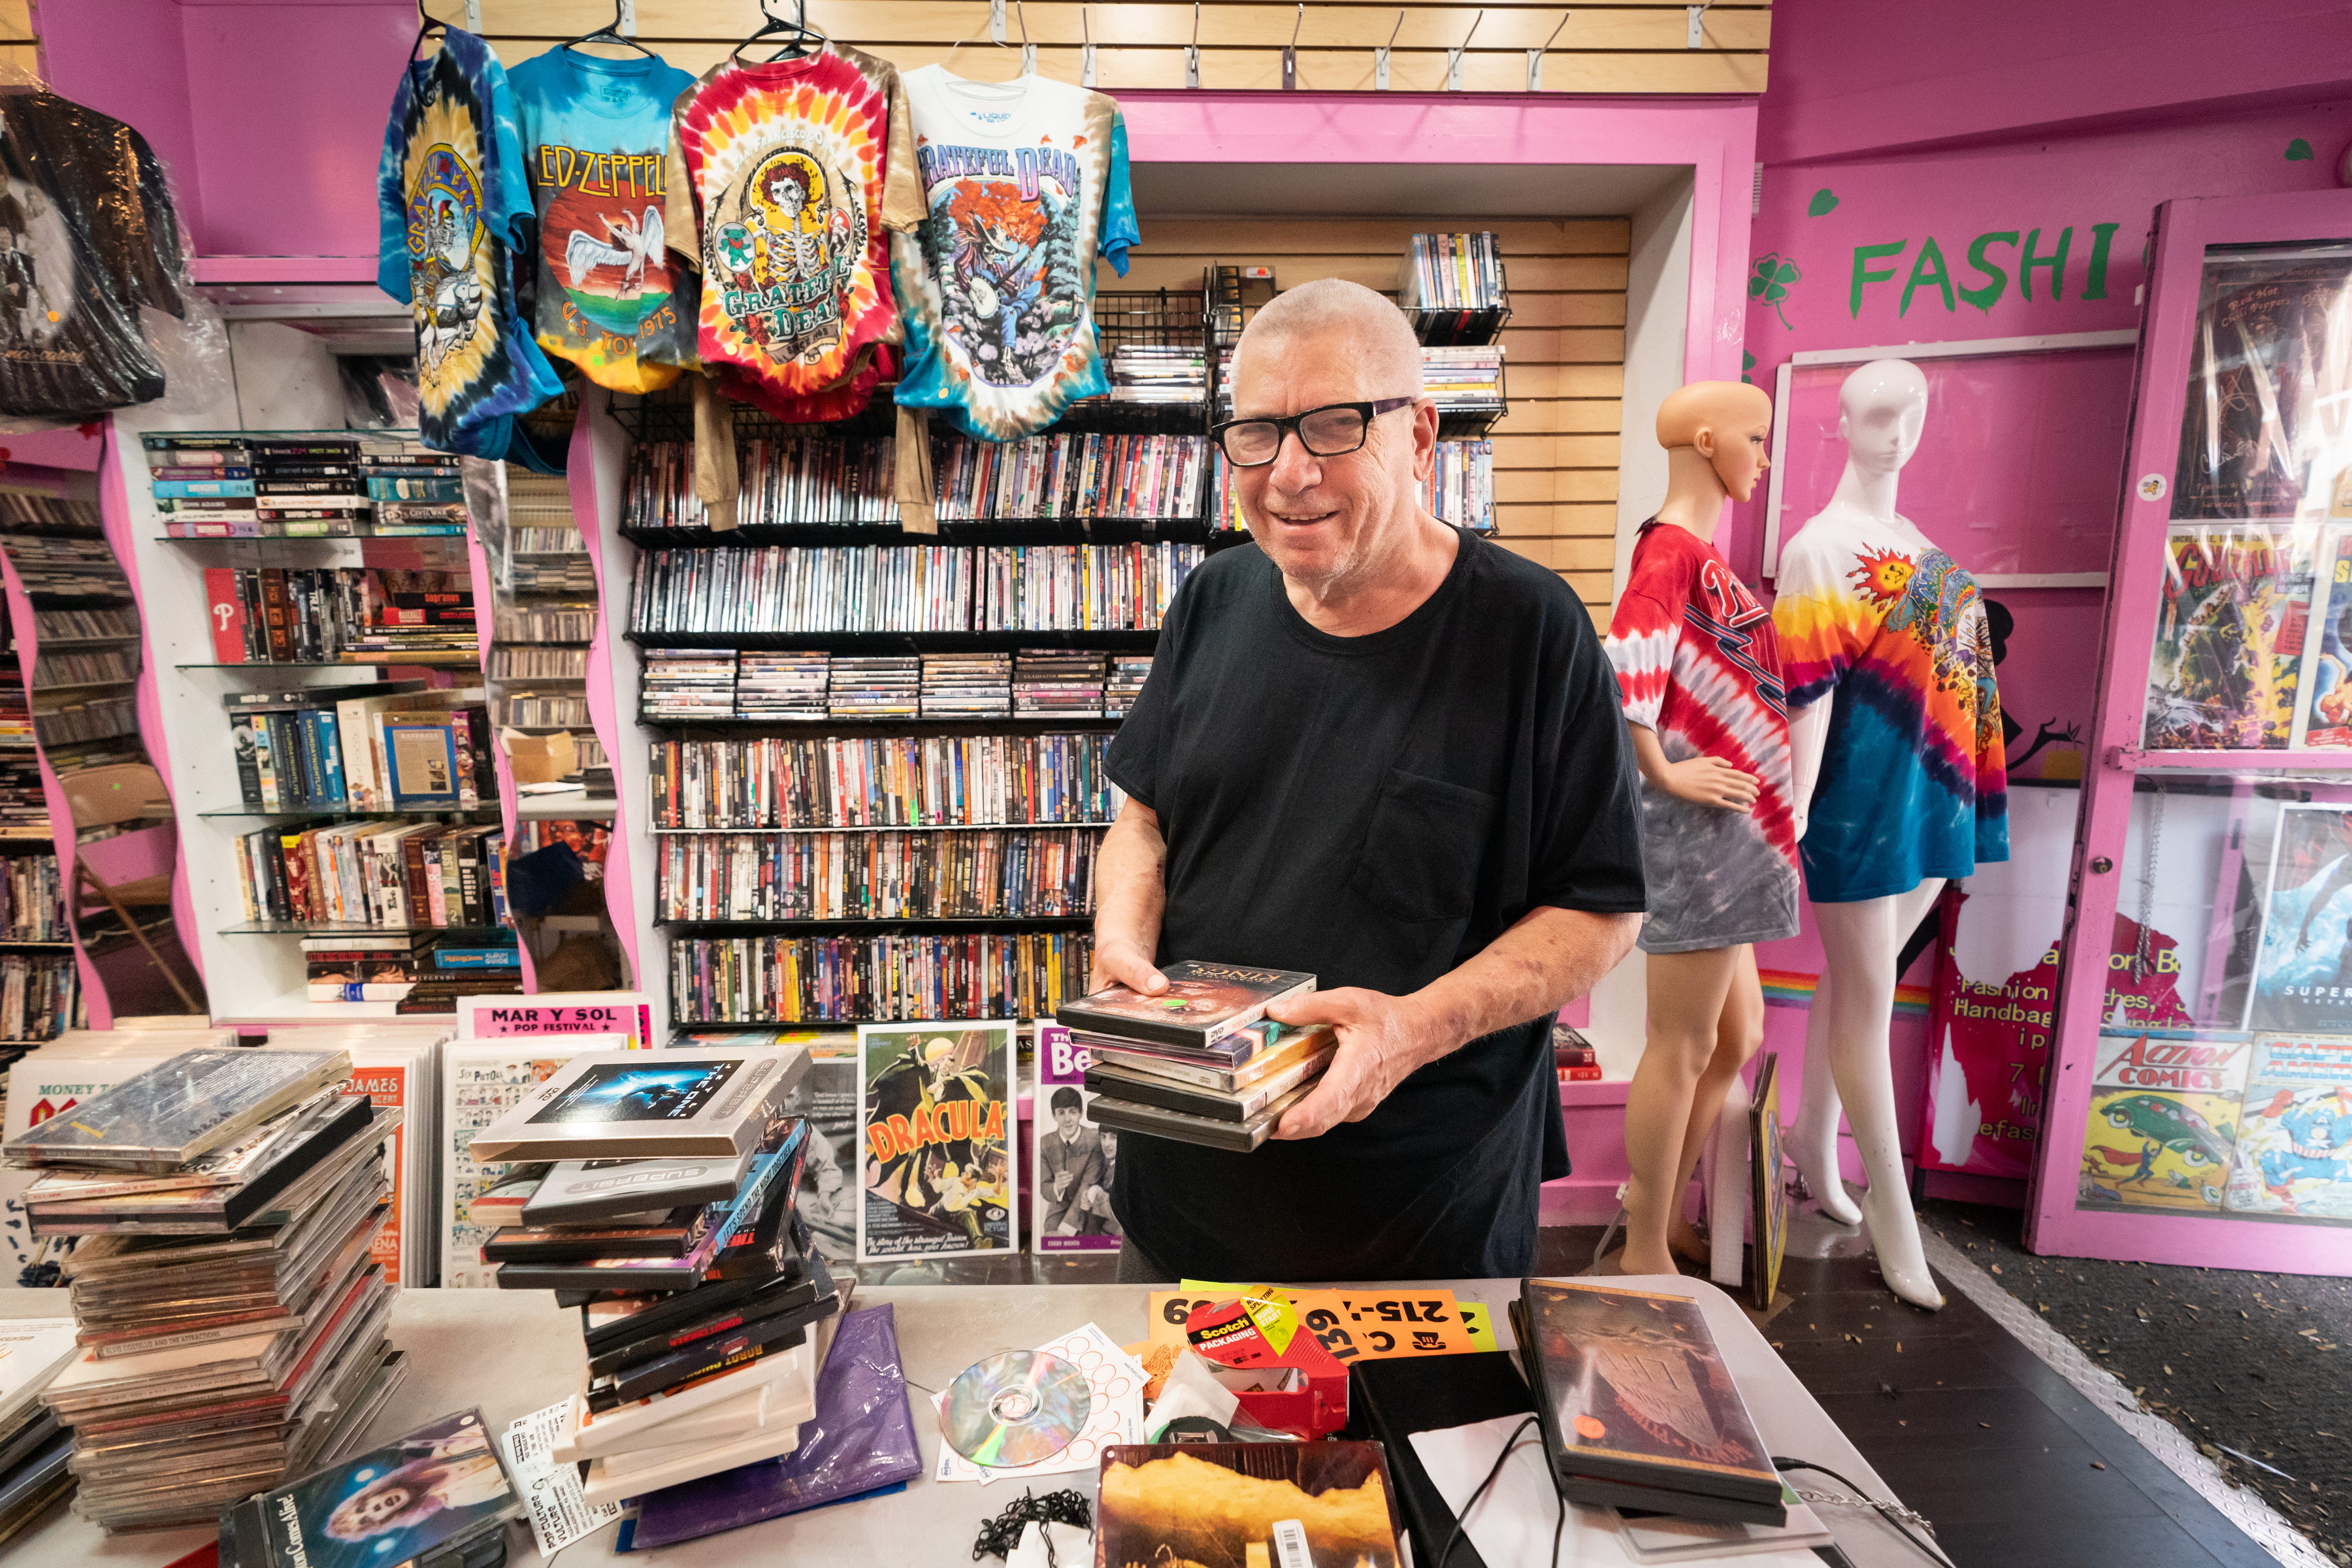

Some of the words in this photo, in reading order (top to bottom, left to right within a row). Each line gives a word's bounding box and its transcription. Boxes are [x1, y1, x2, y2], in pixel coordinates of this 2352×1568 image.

[1015, 146, 1077, 203] DEAD
[723, 254, 851, 319] GRATEFL
[639, 306, 678, 339] 1975
[1177, 449, 1186, 465] HIGH
[1086, 474, 1094, 489] WIZ
[1175, 466, 1184, 488] CRIMES
[410, 508, 431, 516] CIVIL
[431, 507, 447, 515] WAR
[425, 593, 461, 604] Sopranos
[442, 849, 454, 872] LOST
[1961, 977, 2049, 1001] Fashion
[491, 1009, 538, 1022] MAR
[549, 1009, 564, 1021] Y
[576, 1008, 617, 1021] SOL
[1232, 1017, 1248, 1030] WHEN
[514, 1023, 538, 1032] POP
[544, 1022, 596, 1031] FESTIVAL
[1051, 1032, 1070, 1042] Th
[2097, 1032, 2248, 1079] ACTION
[346, 1077, 399, 1093] JAMES
[696, 1062, 725, 1090] THE
[2119, 1068, 2223, 1089] COMICS
[38, 1085, 94, 1095] MONEY
[720, 1062, 773, 1117] SUPERBIT
[666, 1090, 698, 1118] ONE
[578, 1168, 700, 1192] SUPERBIT
[723, 1220, 739, 1240] LET'S
[736, 1198, 751, 1220] SPEND
[751, 1188, 761, 1204] THE
[759, 1171, 773, 1192] NIGHT
[771, 1144, 792, 1173] TOGETHER
[1255, 1305, 1275, 1321] SURE
[1259, 1309, 1282, 1327] START
[1200, 1316, 1250, 1339] Scotch
[105, 1346, 123, 1356] ELVIS
[123, 1341, 153, 1353] COSTELLO
[154, 1338, 167, 1347] AND
[182, 1330, 220, 1343] ATTRACTIONS
[1199, 1328, 1257, 1351] PACKAGING
[532, 1495, 552, 1531] CULTURE
[549, 1505, 567, 1543] VULTURE
